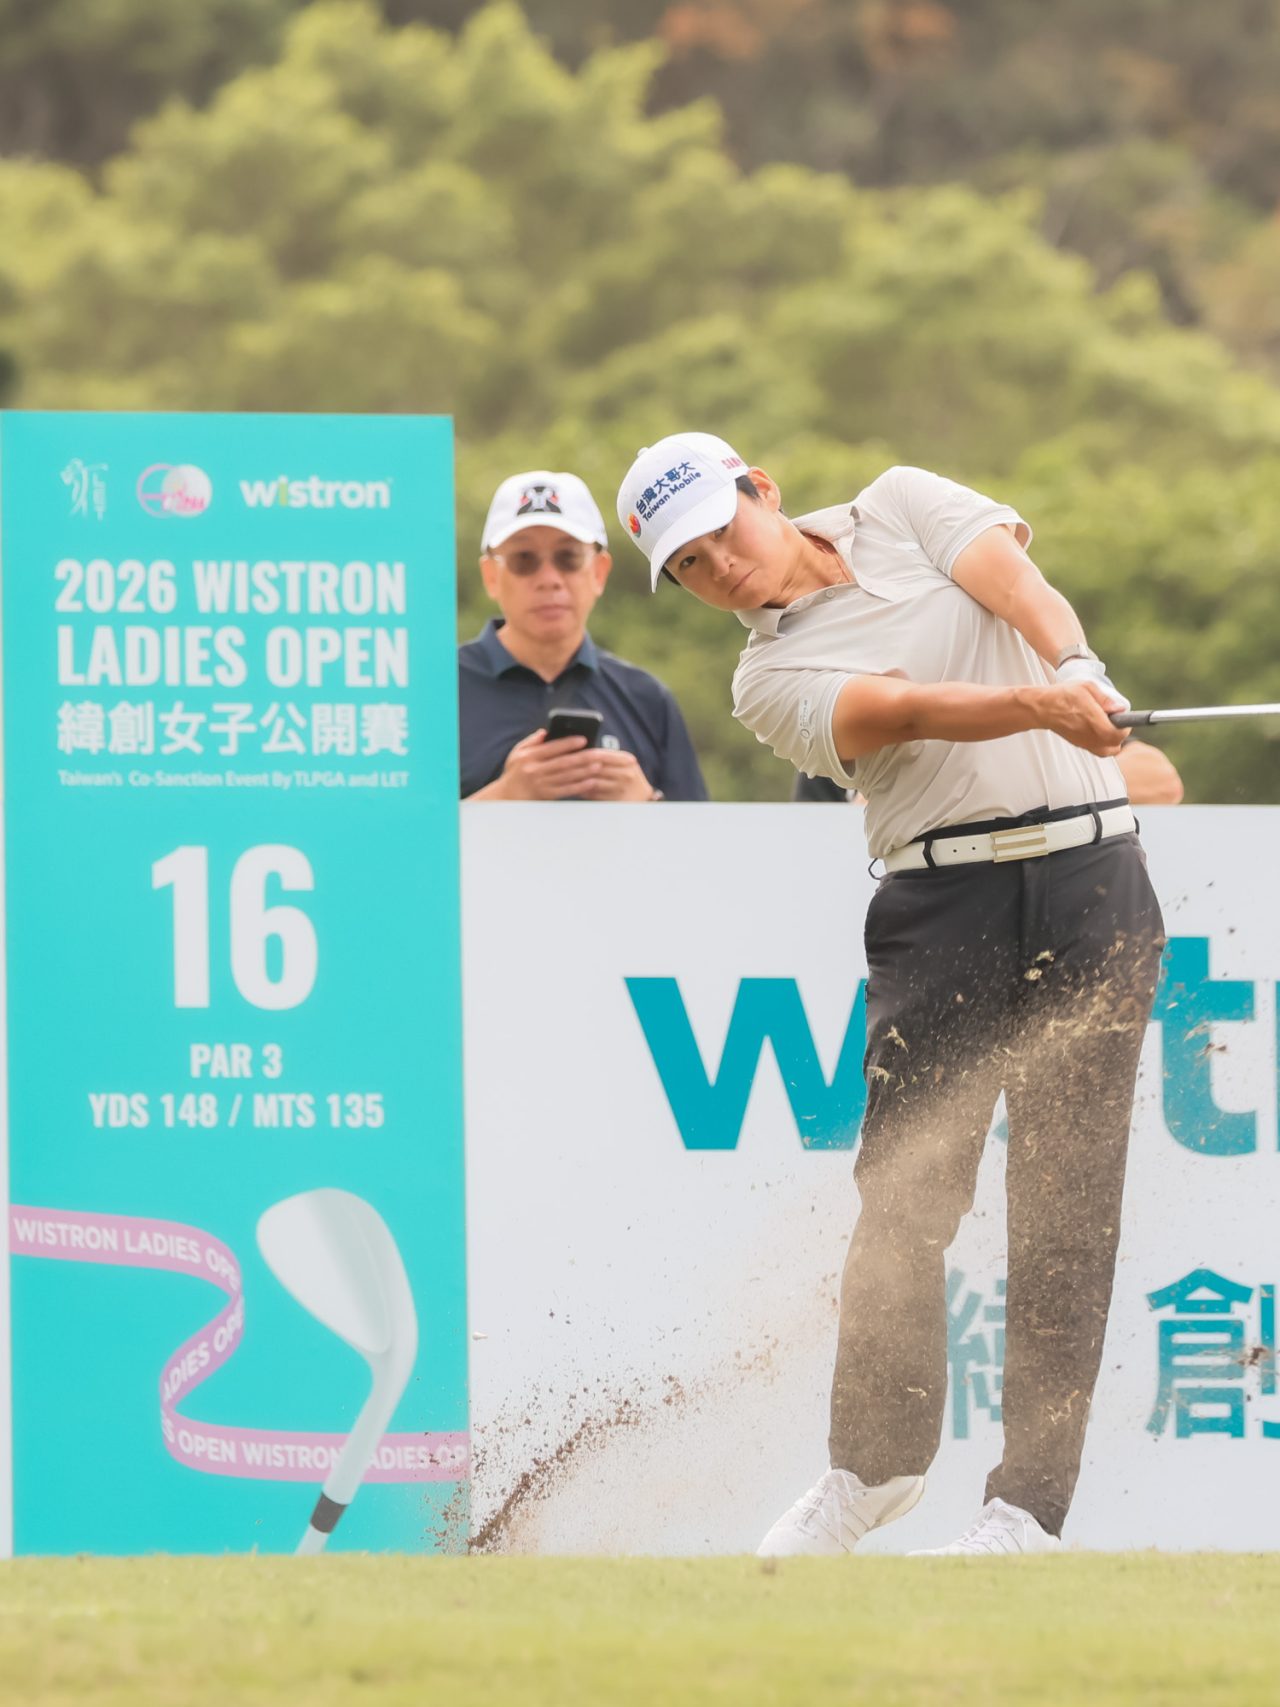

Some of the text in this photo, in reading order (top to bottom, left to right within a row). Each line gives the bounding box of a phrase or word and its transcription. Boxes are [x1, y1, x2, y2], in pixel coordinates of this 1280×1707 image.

[239, 475, 391, 508] wistron
[642, 471, 702, 521] Taiwan Mobile
[54, 559, 406, 614] 2026 WISTRON
[57, 625, 409, 687] LADIES OPEN
[57, 701, 409, 756] 緯創女子公開賽
[225, 771, 269, 787] Event
[272, 771, 292, 790] By
[348, 771, 378, 787] and
[381, 772, 409, 788] LET
[151, 843, 319, 1011] 16
[190, 1043, 283, 1078] PAR 3
[88, 1093, 385, 1128] YDS 148 / MTS 135
[14, 1218, 119, 1252] WISTRON
[124, 1231, 201, 1265] LADIES
[178, 1429, 237, 1464] OPEN
[368, 1445, 429, 1470] ADIES
